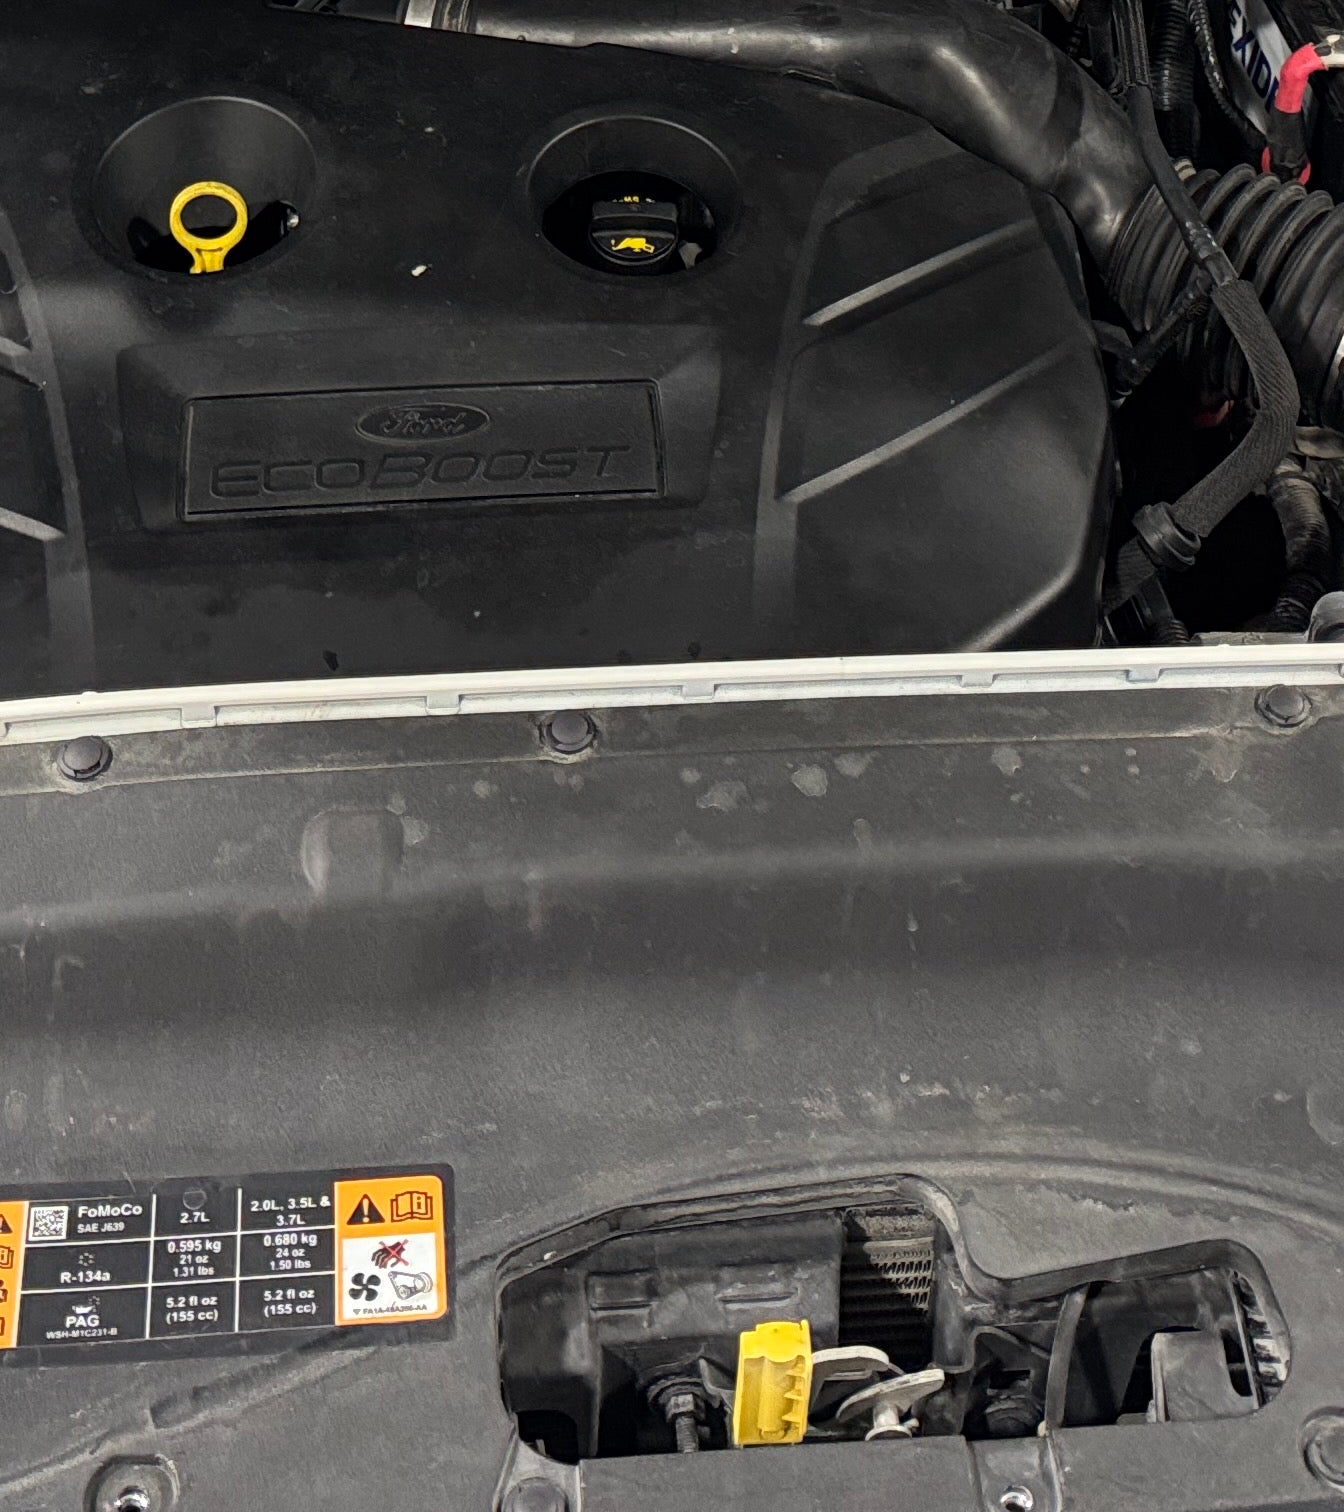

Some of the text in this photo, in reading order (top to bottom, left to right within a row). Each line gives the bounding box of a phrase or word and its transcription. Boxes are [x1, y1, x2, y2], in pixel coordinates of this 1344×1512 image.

[379, 409, 468, 435] Ford
[78, 1204, 143, 1218] FoMoCo
[250, 1196, 331, 1212] 2.0L, 3.5L &
[180, 1212, 210, 1224] 2.7L
[276, 1214, 306, 1226] 3.7L
[77, 1222, 126, 1234] SAE J639
[167, 1240, 222, 1254] 0.595 kg
[263, 1233, 318, 1247] 0.680 kg
[179, 1255, 208, 1265] 21 oz
[276, 1248, 306, 1258] 24 oz
[270, 1258, 312, 1270] 1.50 lbs
[60, 1270, 112, 1284] R-134a
[173, 1266, 215, 1278] 1.31 lbs
[263, 1288, 316, 1302] 5.2 fl oz
[166, 1296, 218, 1309] 5.2 fl oz
[166, 1309, 219, 1324] (155 cc)
[264, 1302, 317, 1318] (155 cc)
[65, 1314, 100, 1328] PAG
